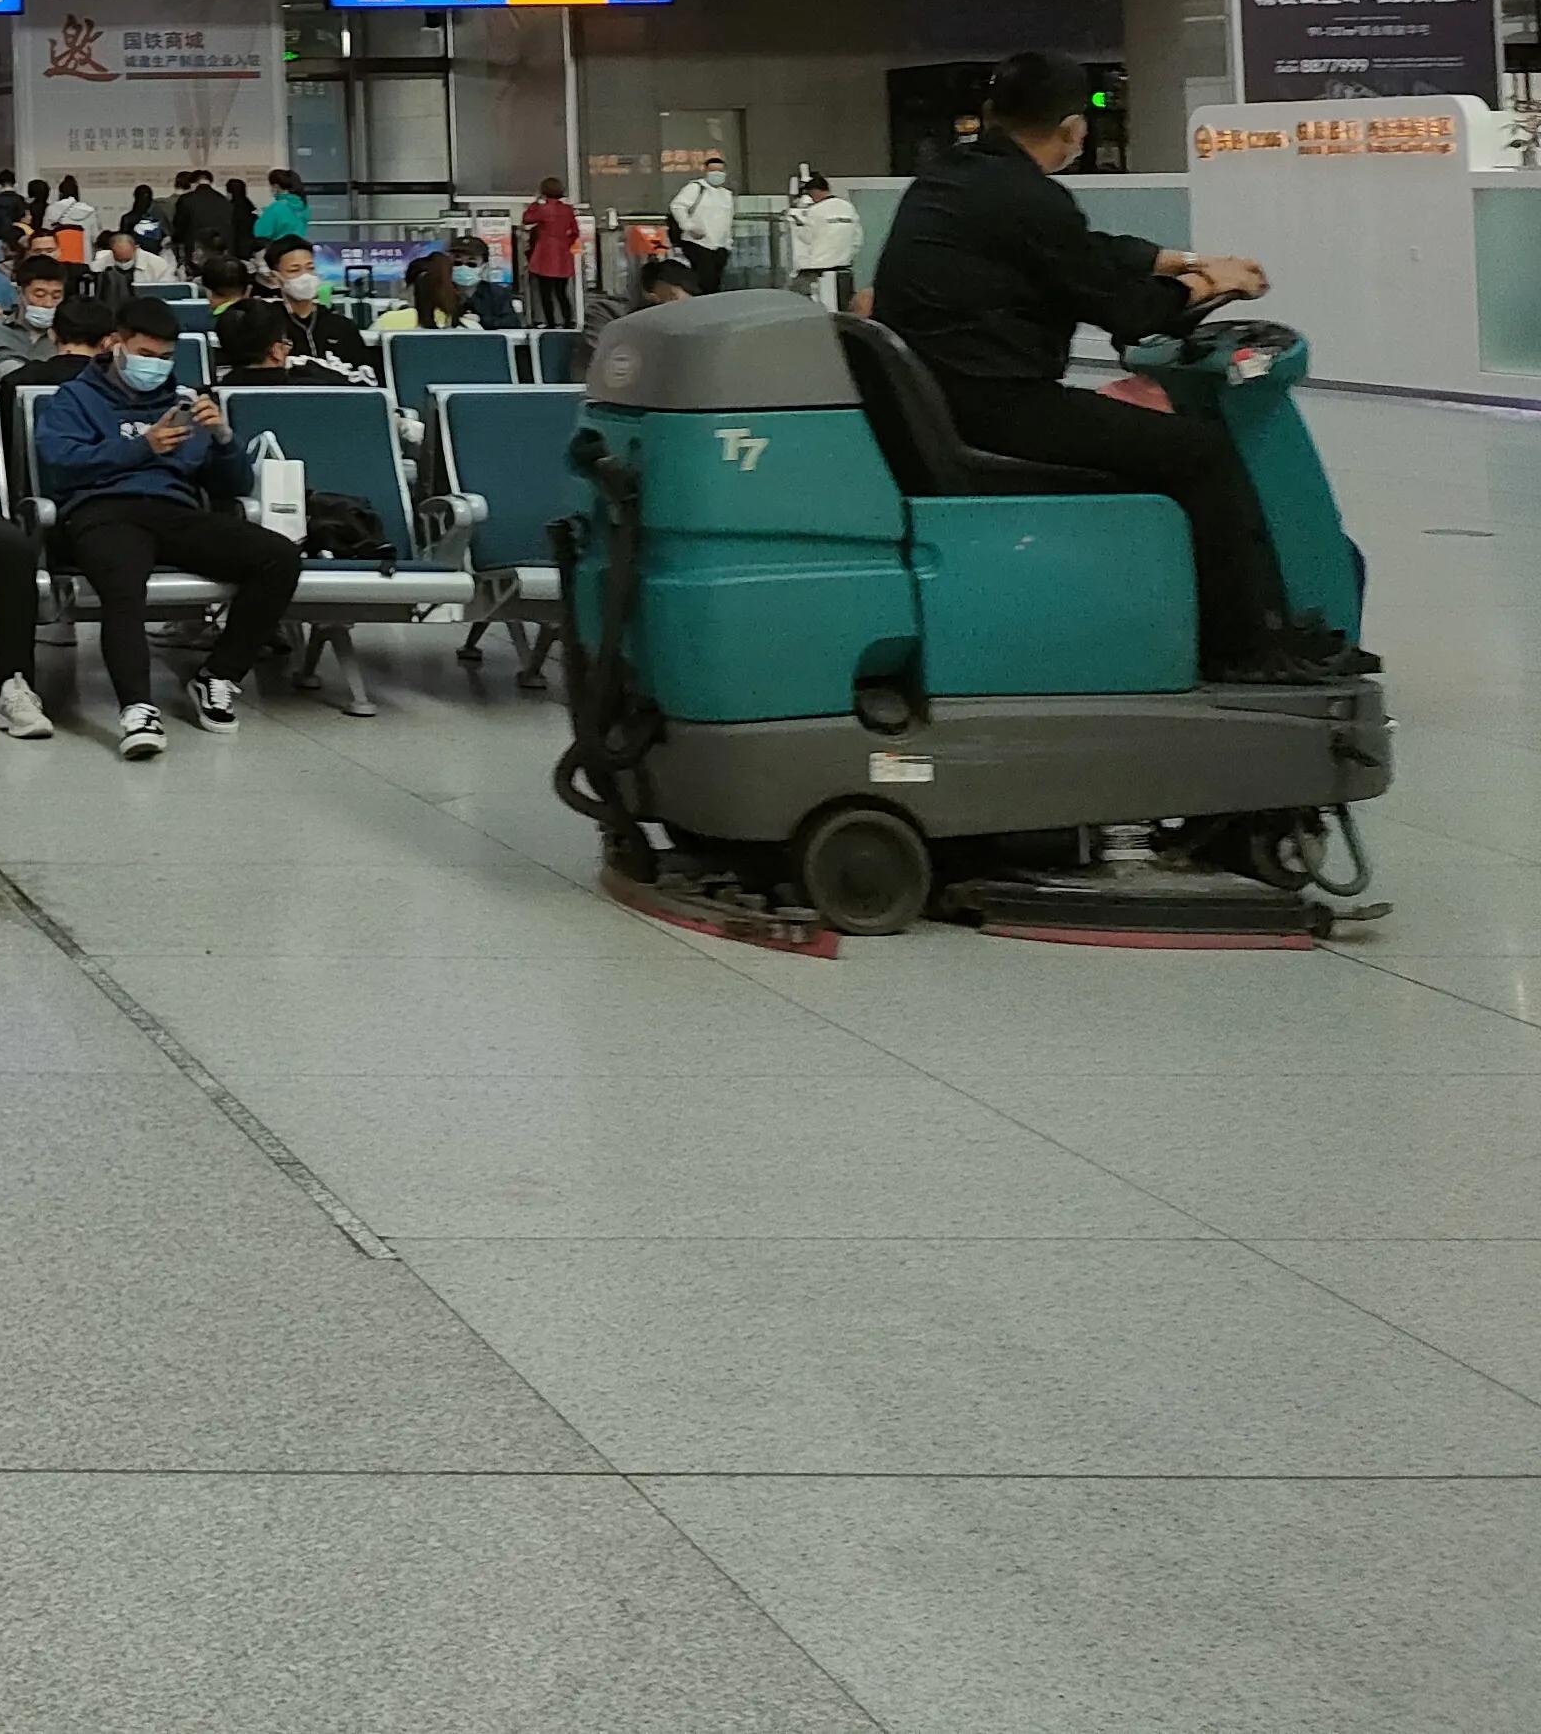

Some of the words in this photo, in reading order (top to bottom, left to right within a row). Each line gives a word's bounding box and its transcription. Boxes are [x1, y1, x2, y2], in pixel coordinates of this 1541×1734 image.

[123, 31, 205, 50] 国铁商城
[714, 428, 770, 471] T7
